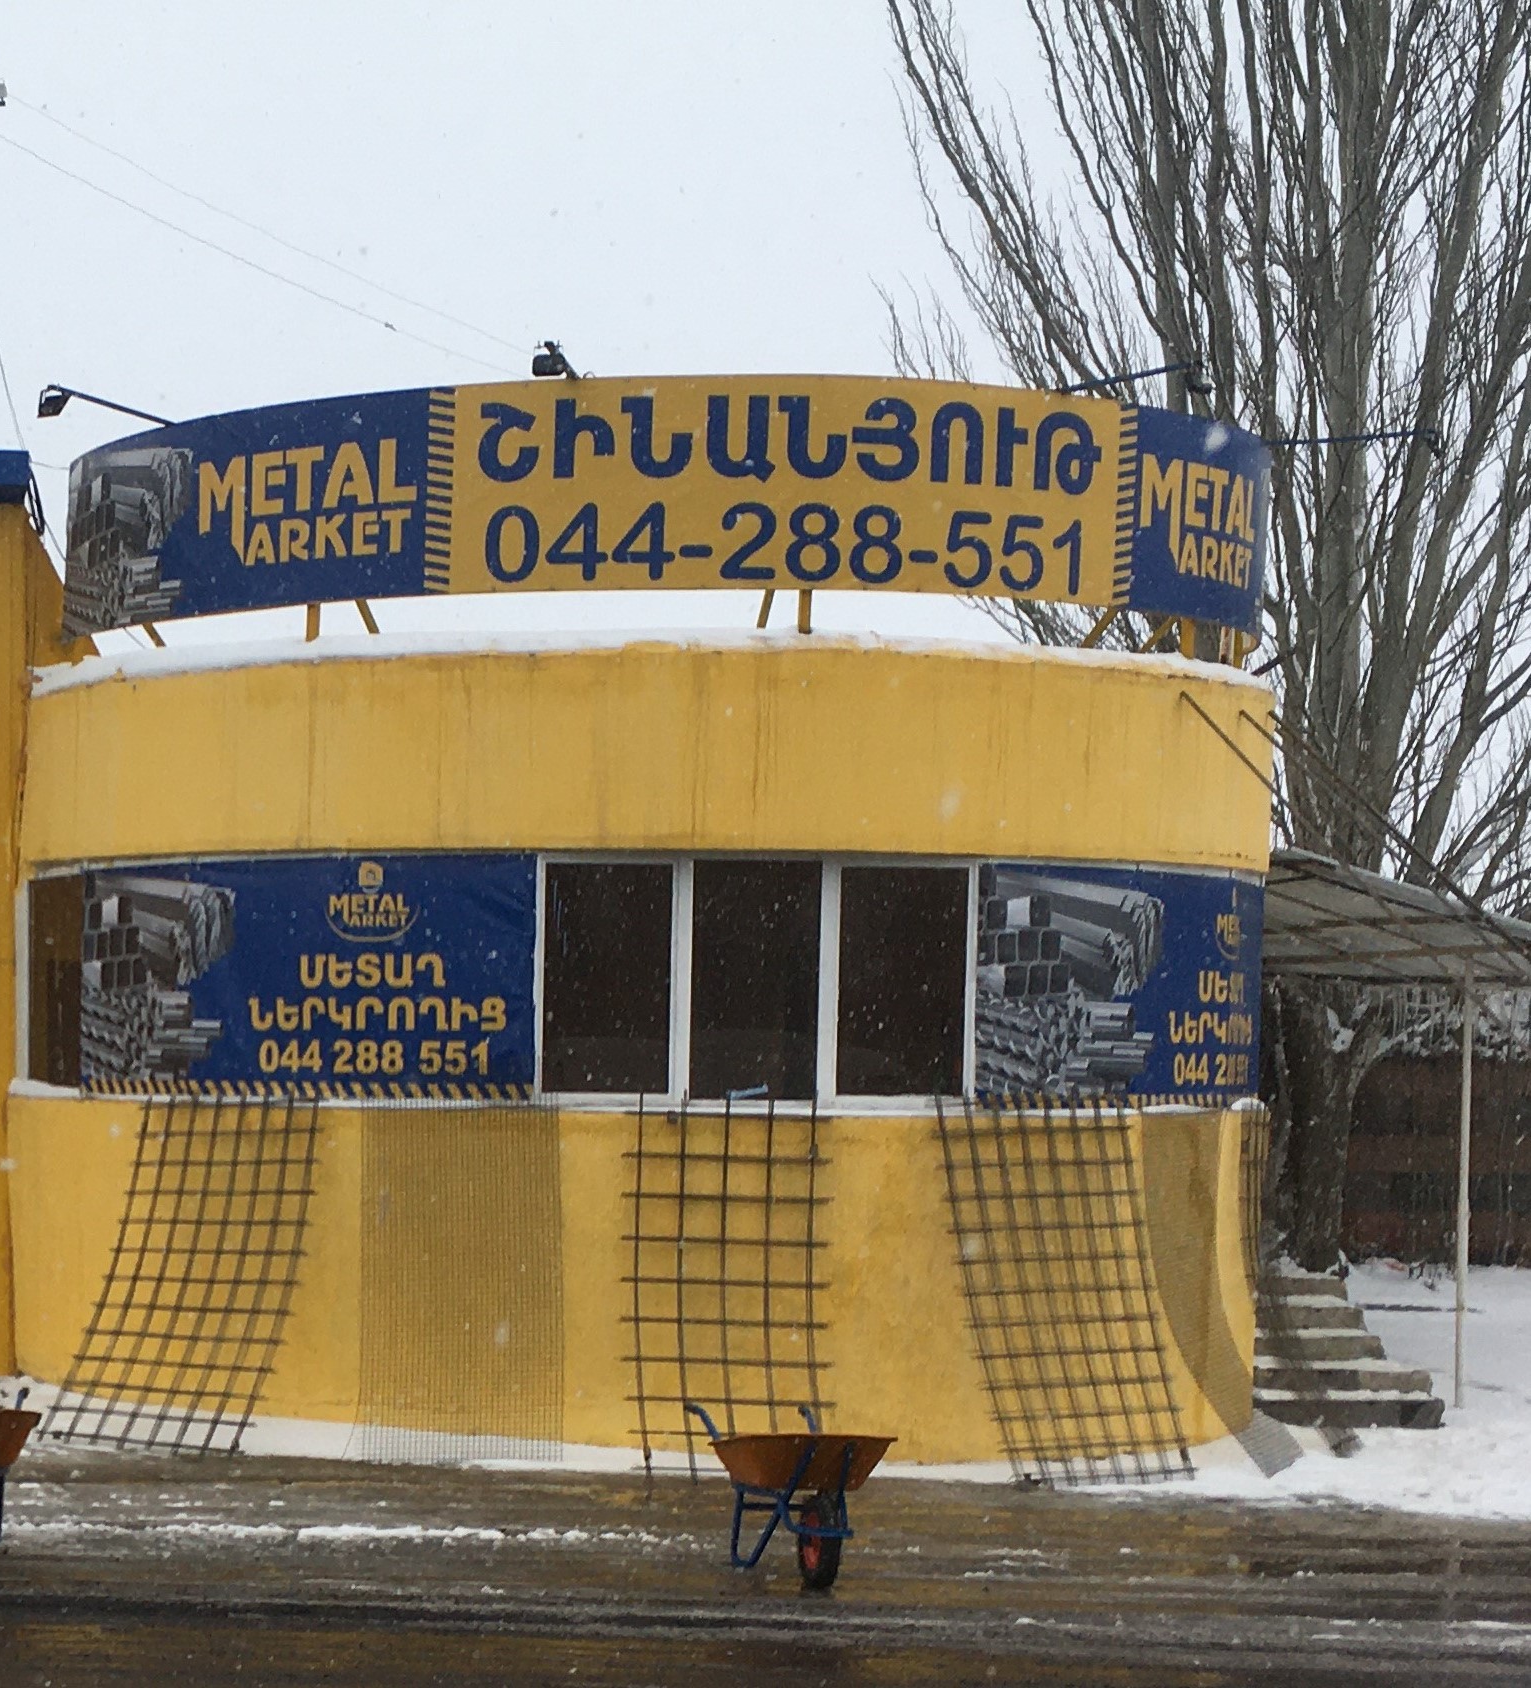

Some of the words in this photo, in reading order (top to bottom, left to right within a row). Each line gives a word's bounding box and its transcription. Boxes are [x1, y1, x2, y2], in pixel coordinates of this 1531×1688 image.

[477, 394, 1103, 496] ՇԻՆԱՆՅՈՒԹ
[198, 438, 418, 564] METAL
[1139, 453, 1256, 565] METAL
[483, 502, 1083, 596] 044-288-551
[329, 893, 410, 921] METAL
[299, 953, 446, 989] ՄԵՏԱՂ
[248, 995, 507, 1033] ՆԵՐԿՐՈՂԻՑ
[258, 1038, 323, 1074] 044
[333, 1039, 404, 1075] 288
[419, 1040, 489, 1076] 551
[1173, 1052, 1209, 1086] 044
